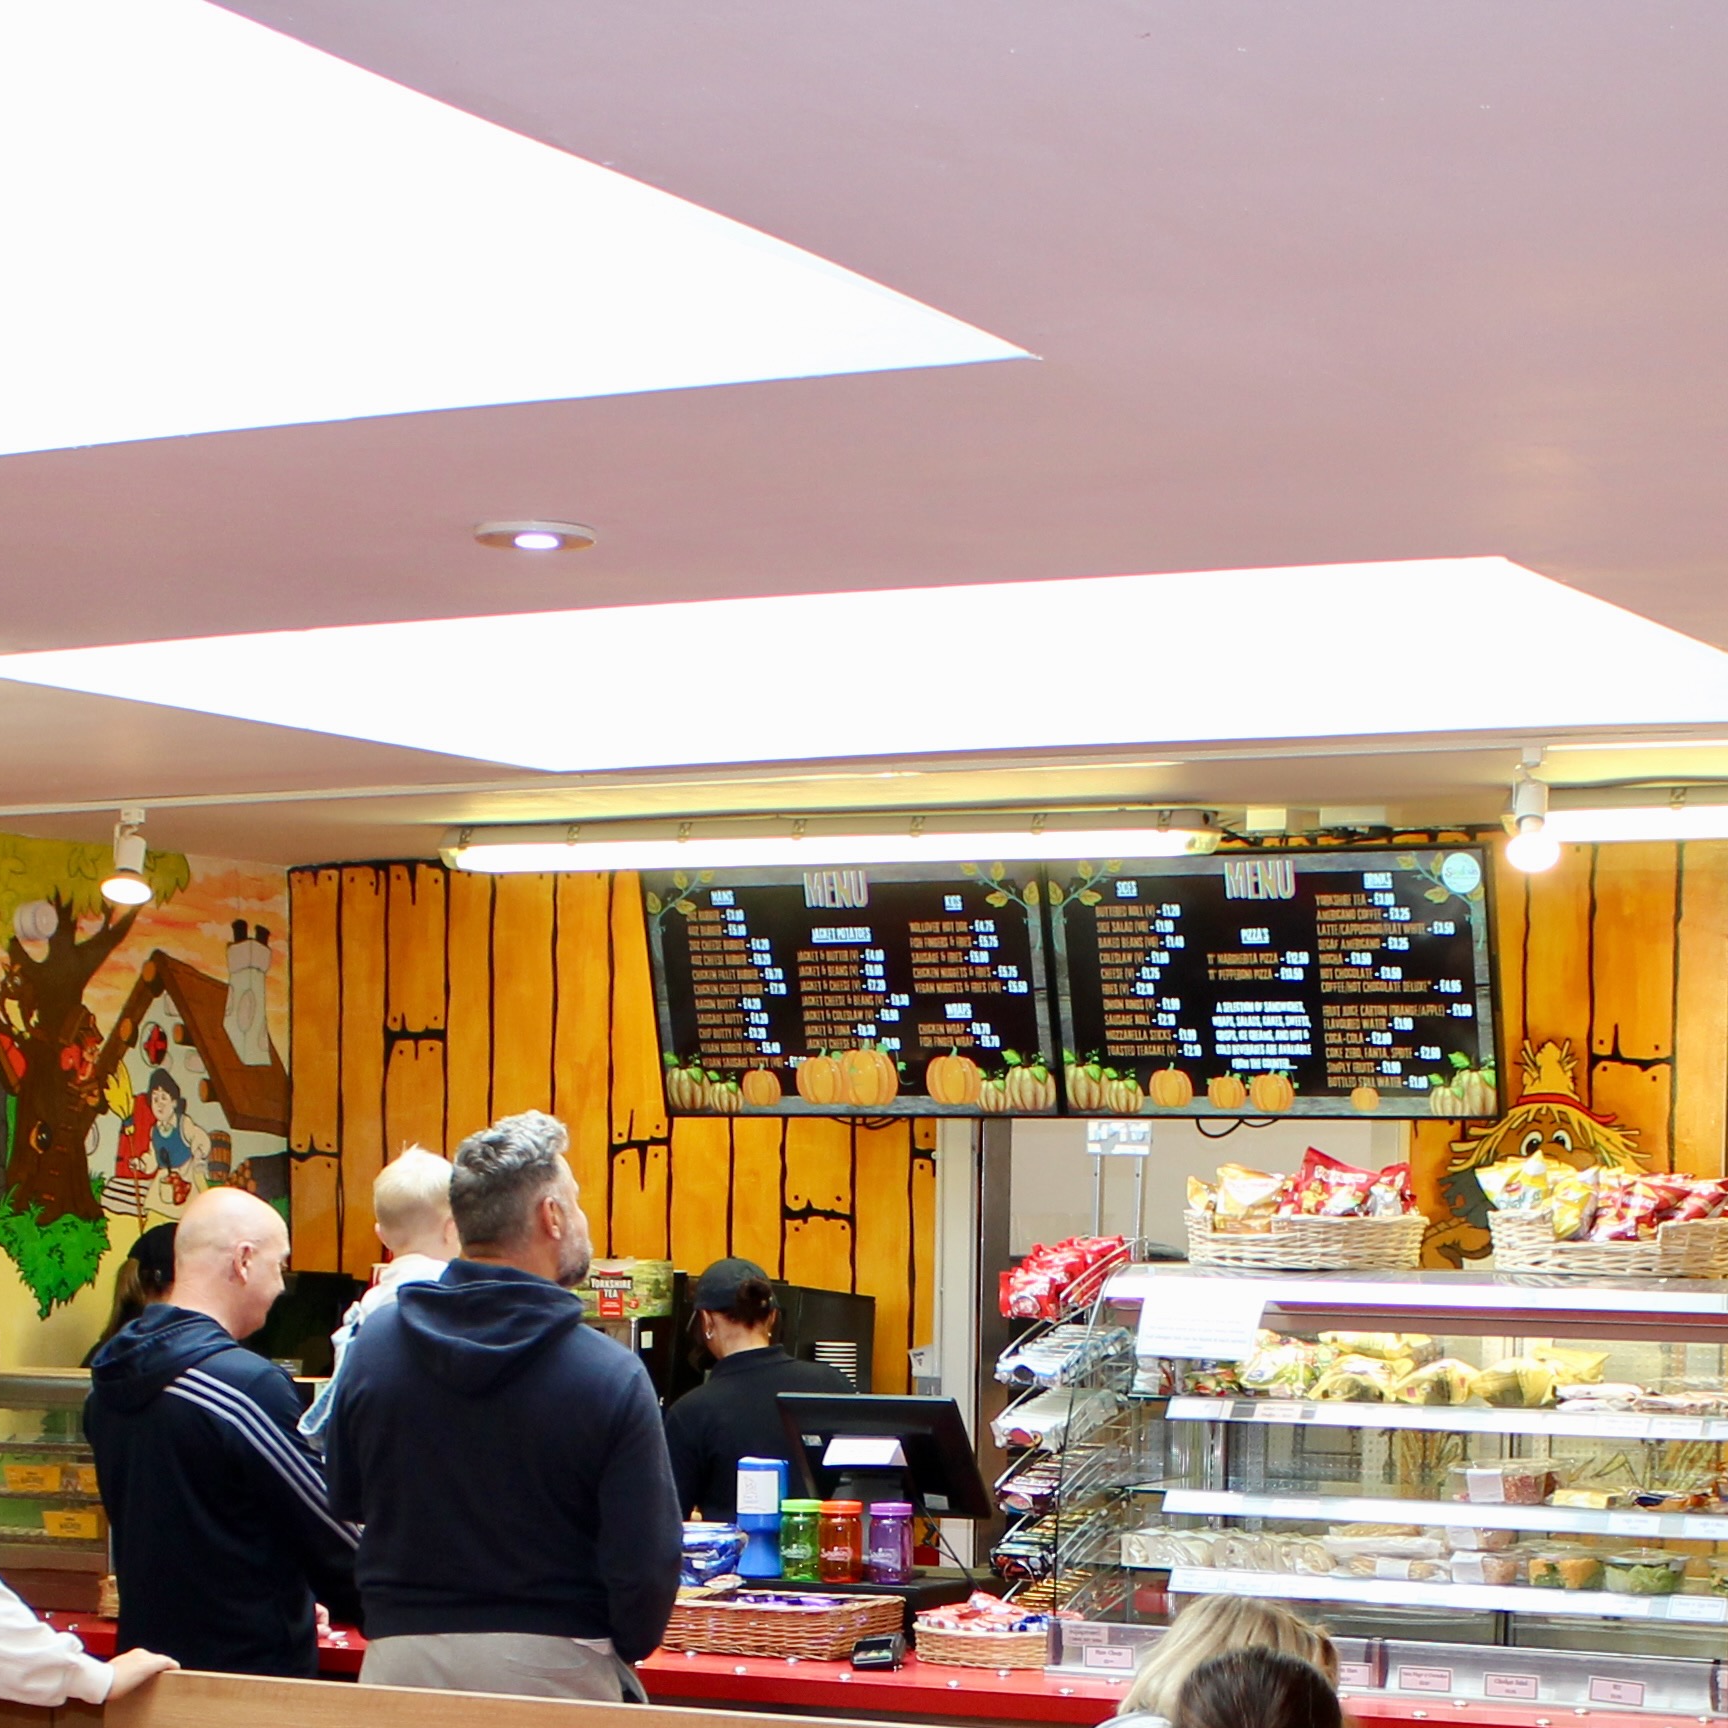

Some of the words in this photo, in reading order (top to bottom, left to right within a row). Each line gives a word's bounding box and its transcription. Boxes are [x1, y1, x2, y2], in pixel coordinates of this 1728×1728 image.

[1224, 860, 1295, 899] MENU
[804, 871, 868, 908] MENU
[1116, 881, 1138, 897] SIDES
[812, 928, 836, 943] JACKET
[797, 950, 818, 962] JACKET
[799, 965, 820, 976] JACKET
[1100, 968, 1123, 979] CHEESE
[800, 980, 821, 991] JACKET
[802, 995, 823, 1007] JACKET
[803, 1010, 824, 1021] JACKET
[945, 1003, 972, 1018] WRAPS
[805, 1025, 826, 1036] JACKET
[591, 1278, 632, 1289] YORKSHIRE
[604, 1289, 618, 1298] TEA
